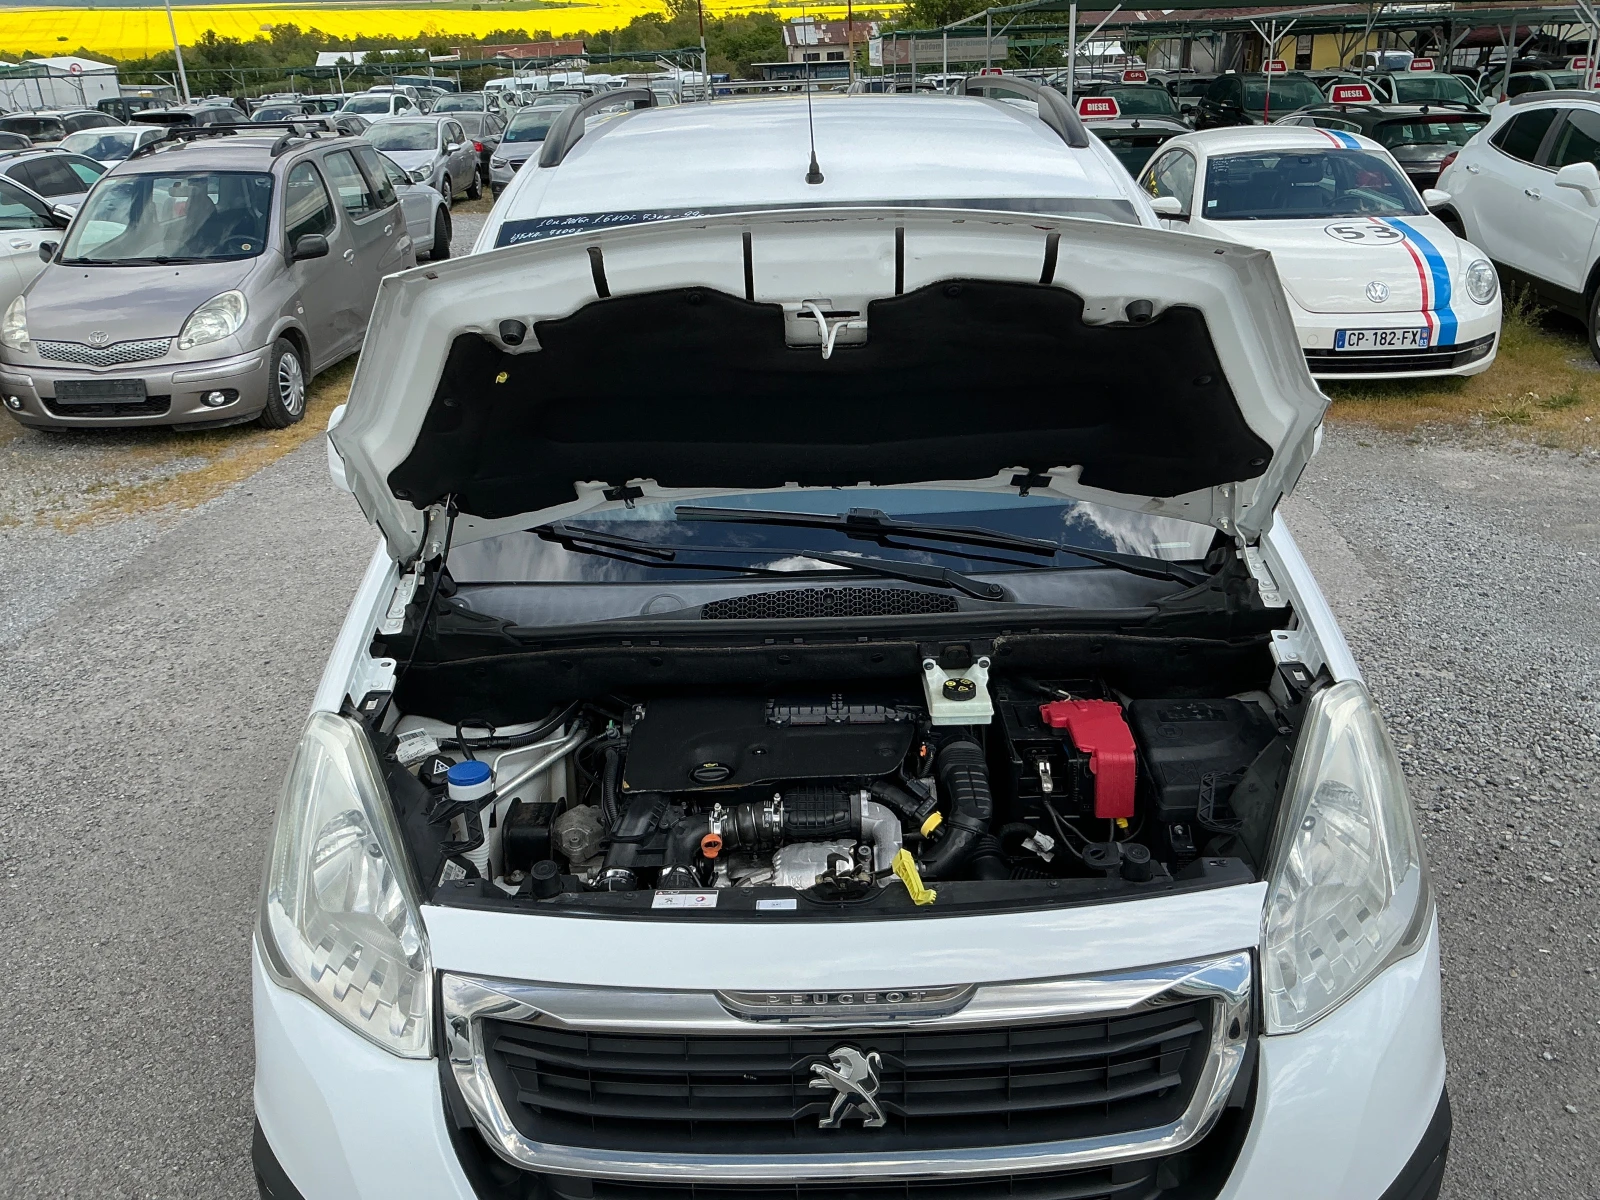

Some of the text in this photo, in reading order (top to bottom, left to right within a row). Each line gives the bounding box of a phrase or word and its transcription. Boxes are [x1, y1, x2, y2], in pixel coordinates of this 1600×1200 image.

[1340, 89, 1364, 98] DIESEL
[1087, 102, 1110, 111] DIESEL
[1332, 225, 1400, 240] 53
[1347, 330, 1419, 347] CP-182-FX
[766, 991, 927, 1006] PEUGEOT
